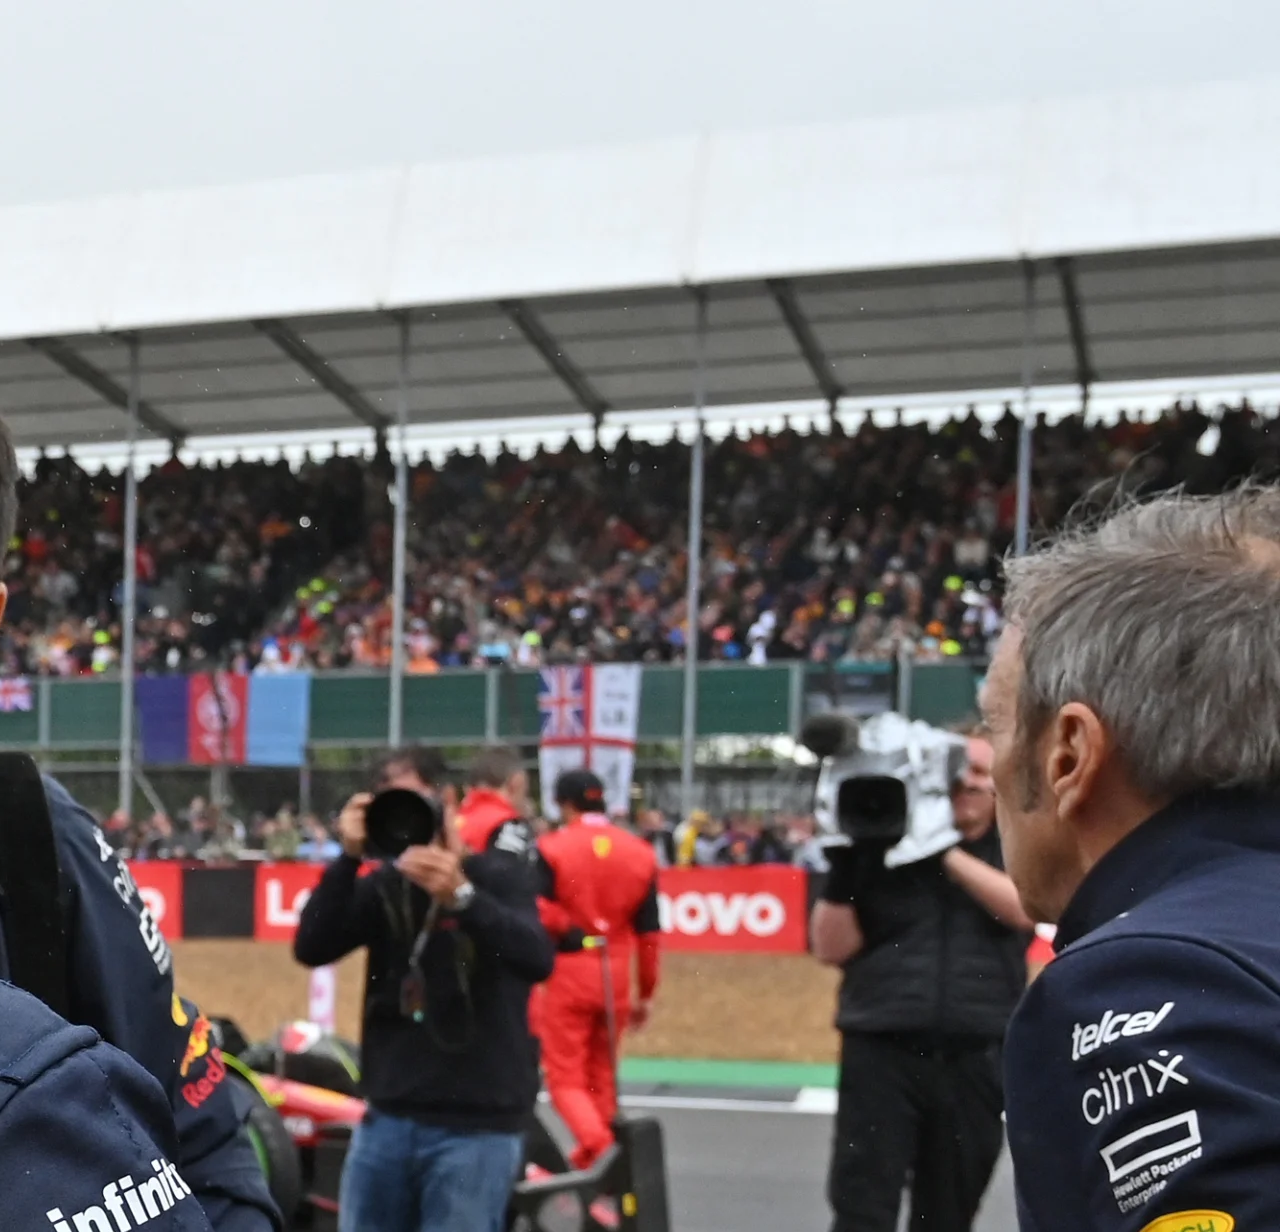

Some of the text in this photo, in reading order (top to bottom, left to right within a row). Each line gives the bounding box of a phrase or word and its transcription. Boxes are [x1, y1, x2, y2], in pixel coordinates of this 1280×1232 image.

[1072, 1002, 1175, 1061] telcel
[1082, 1049, 1189, 1125] citrix
[1150, 1146, 1202, 1179] Packard
